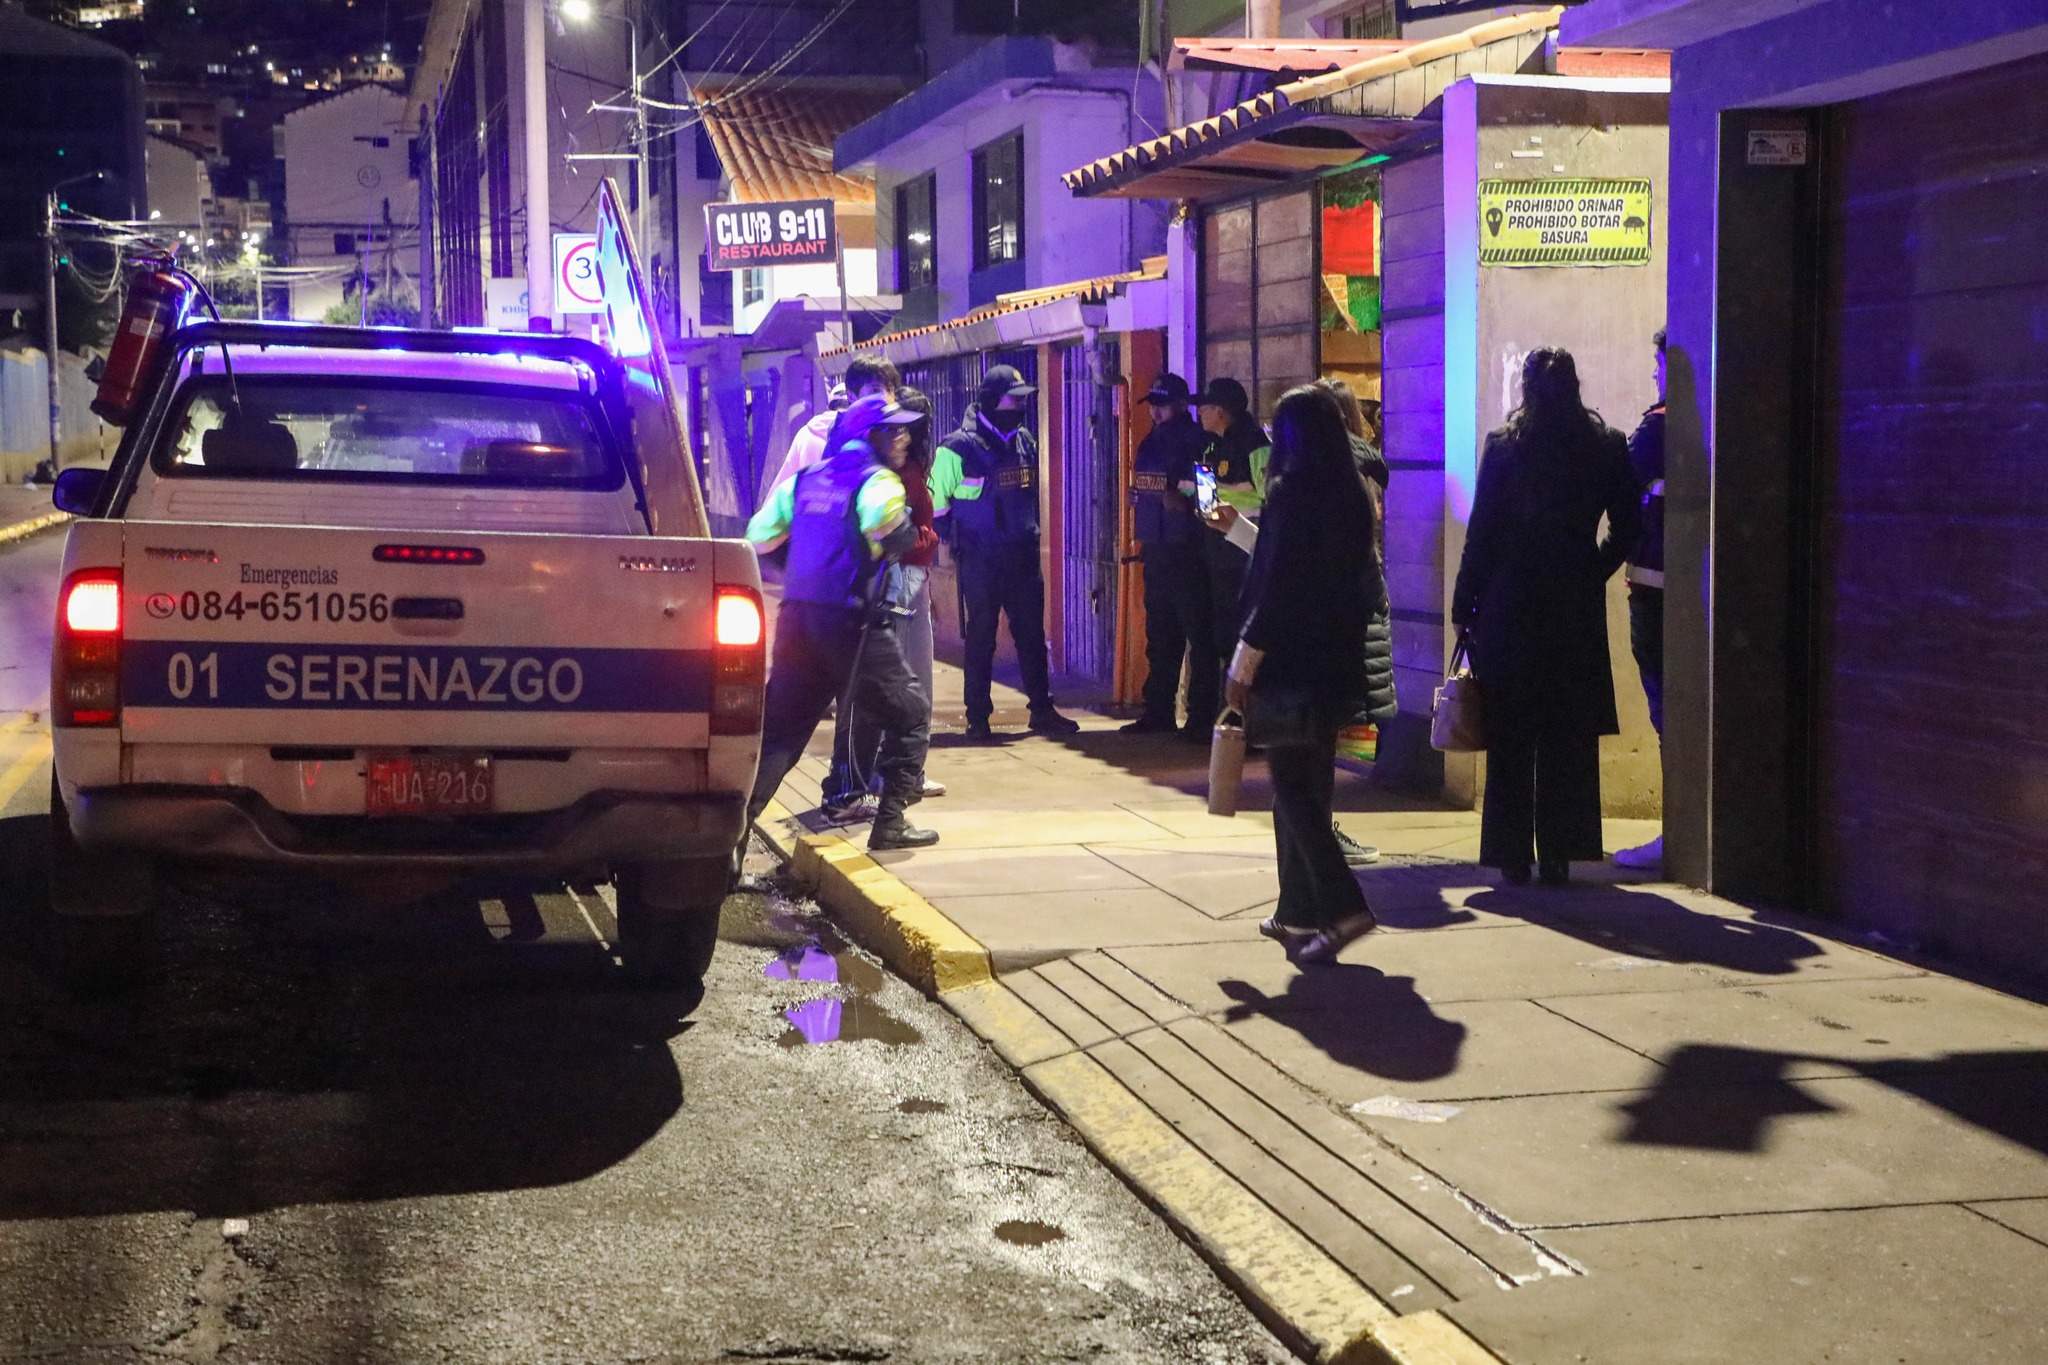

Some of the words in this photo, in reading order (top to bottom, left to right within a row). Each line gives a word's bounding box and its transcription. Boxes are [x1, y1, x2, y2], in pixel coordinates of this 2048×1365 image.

[1505, 199, 1574, 213] PROHIBIDO
[1578, 198, 1624, 212] ORINAR
[716, 211, 772, 246] CLUB
[778, 208, 827, 242] 9:11
[1508, 215, 1577, 229] PROHIBIDO
[1581, 214, 1621, 228] BOTAR
[1540, 231, 1589, 245] BASURA
[718, 240, 827, 260] RESTAURANT
[240, 563, 339, 590] Emergencias
[180, 590, 389, 622] 084-651056
[167, 652, 219, 699] 01
[265, 654, 584, 704] SERENAZGO
